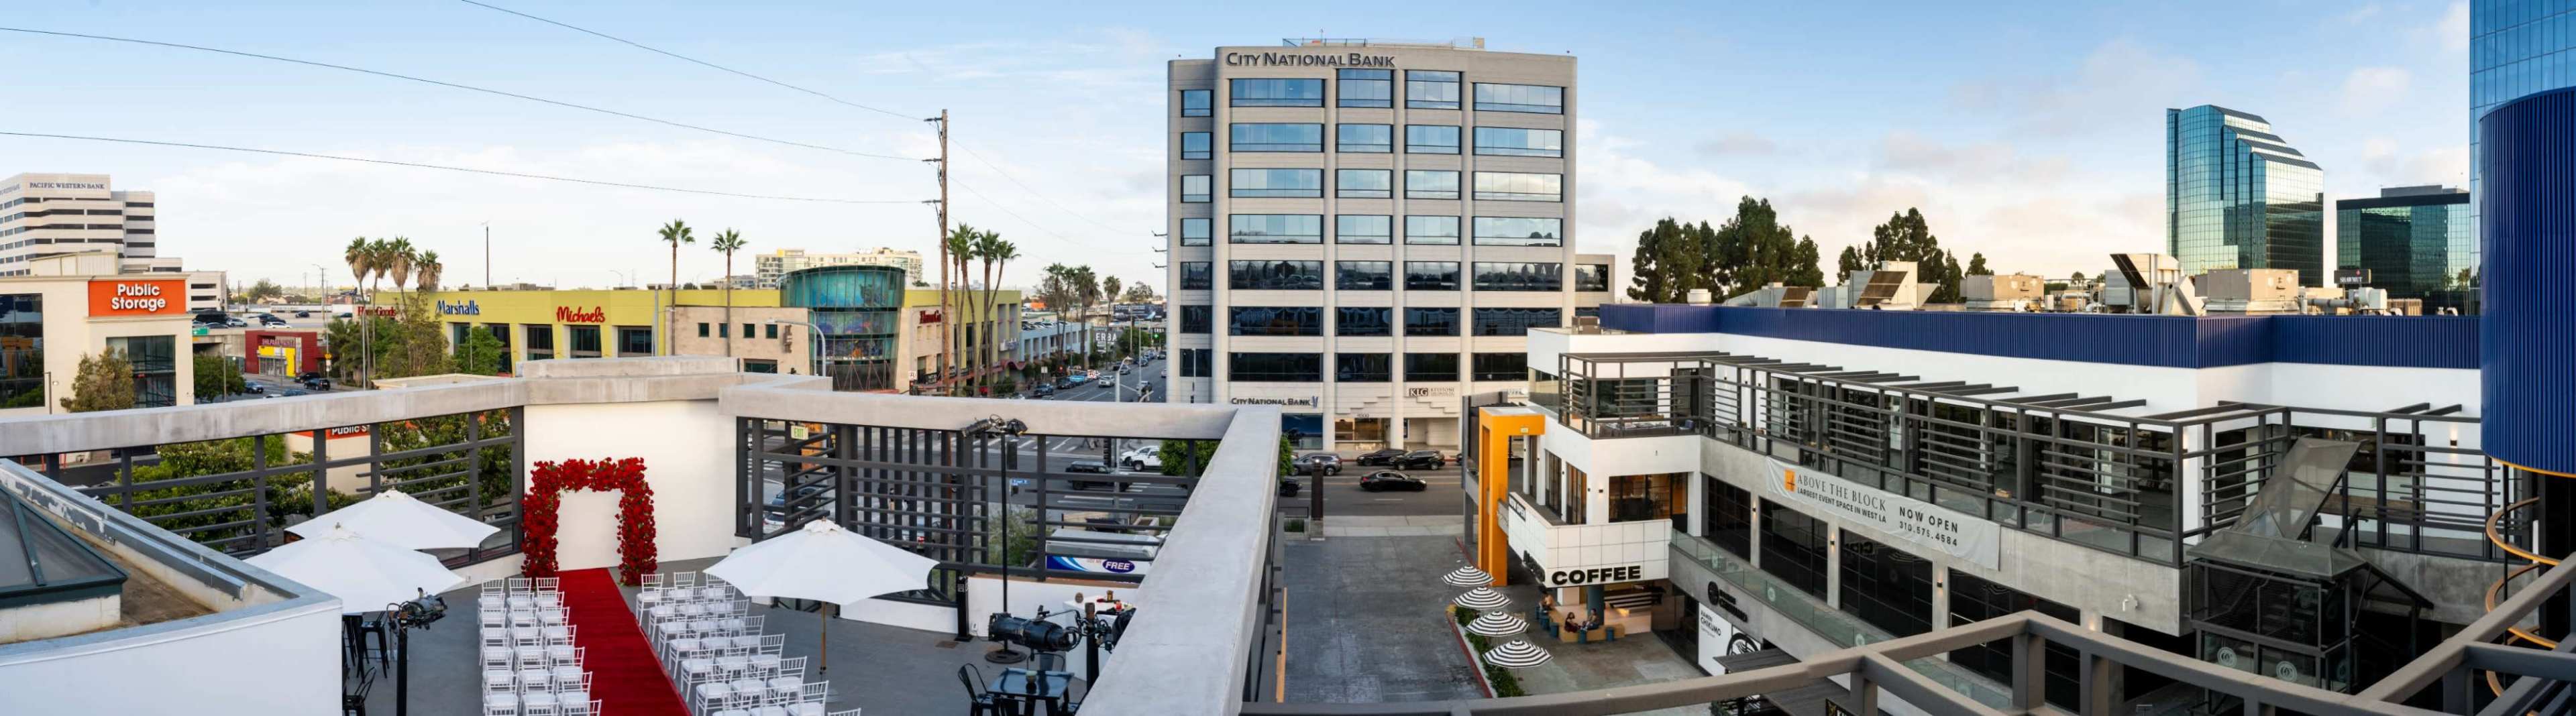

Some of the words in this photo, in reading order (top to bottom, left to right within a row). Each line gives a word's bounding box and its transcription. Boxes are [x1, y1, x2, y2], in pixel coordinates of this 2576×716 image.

[1227, 52, 1260, 66] CITY
[1264, 52, 1345, 66] NATIONAL
[1349, 53, 1395, 68] BANK
[117, 283, 160, 296] Public
[111, 297, 166, 312] Storage
[436, 300, 480, 315] Marshalls
[556, 306, 606, 322] Michaels
[1095, 333, 1117, 341] ERBA
[1410, 388, 1428, 397] KLG
[1248, 398, 1287, 406] NATIONAL
[1798, 475, 1826, 492] ABOVE
[1830, 483, 1848, 499] THE
[1852, 490, 1886, 512] BLOCK
[1798, 487, 1818, 499] LARGEST
[1819, 495, 1835, 505] EVENT
[1836, 500, 1854, 512] SPACE
[1854, 506, 1860, 514] IN
[1862, 509, 1878, 520] WEST
[1879, 515, 1886, 523] LA
[1900, 506, 1923, 522] NOW
[1929, 516, 1957, 533] OPEN
[1900, 521, 1957, 546] 310.575.4584
[1105, 561, 1130, 571] FREE
[1552, 565, 1641, 585] COFFEE
